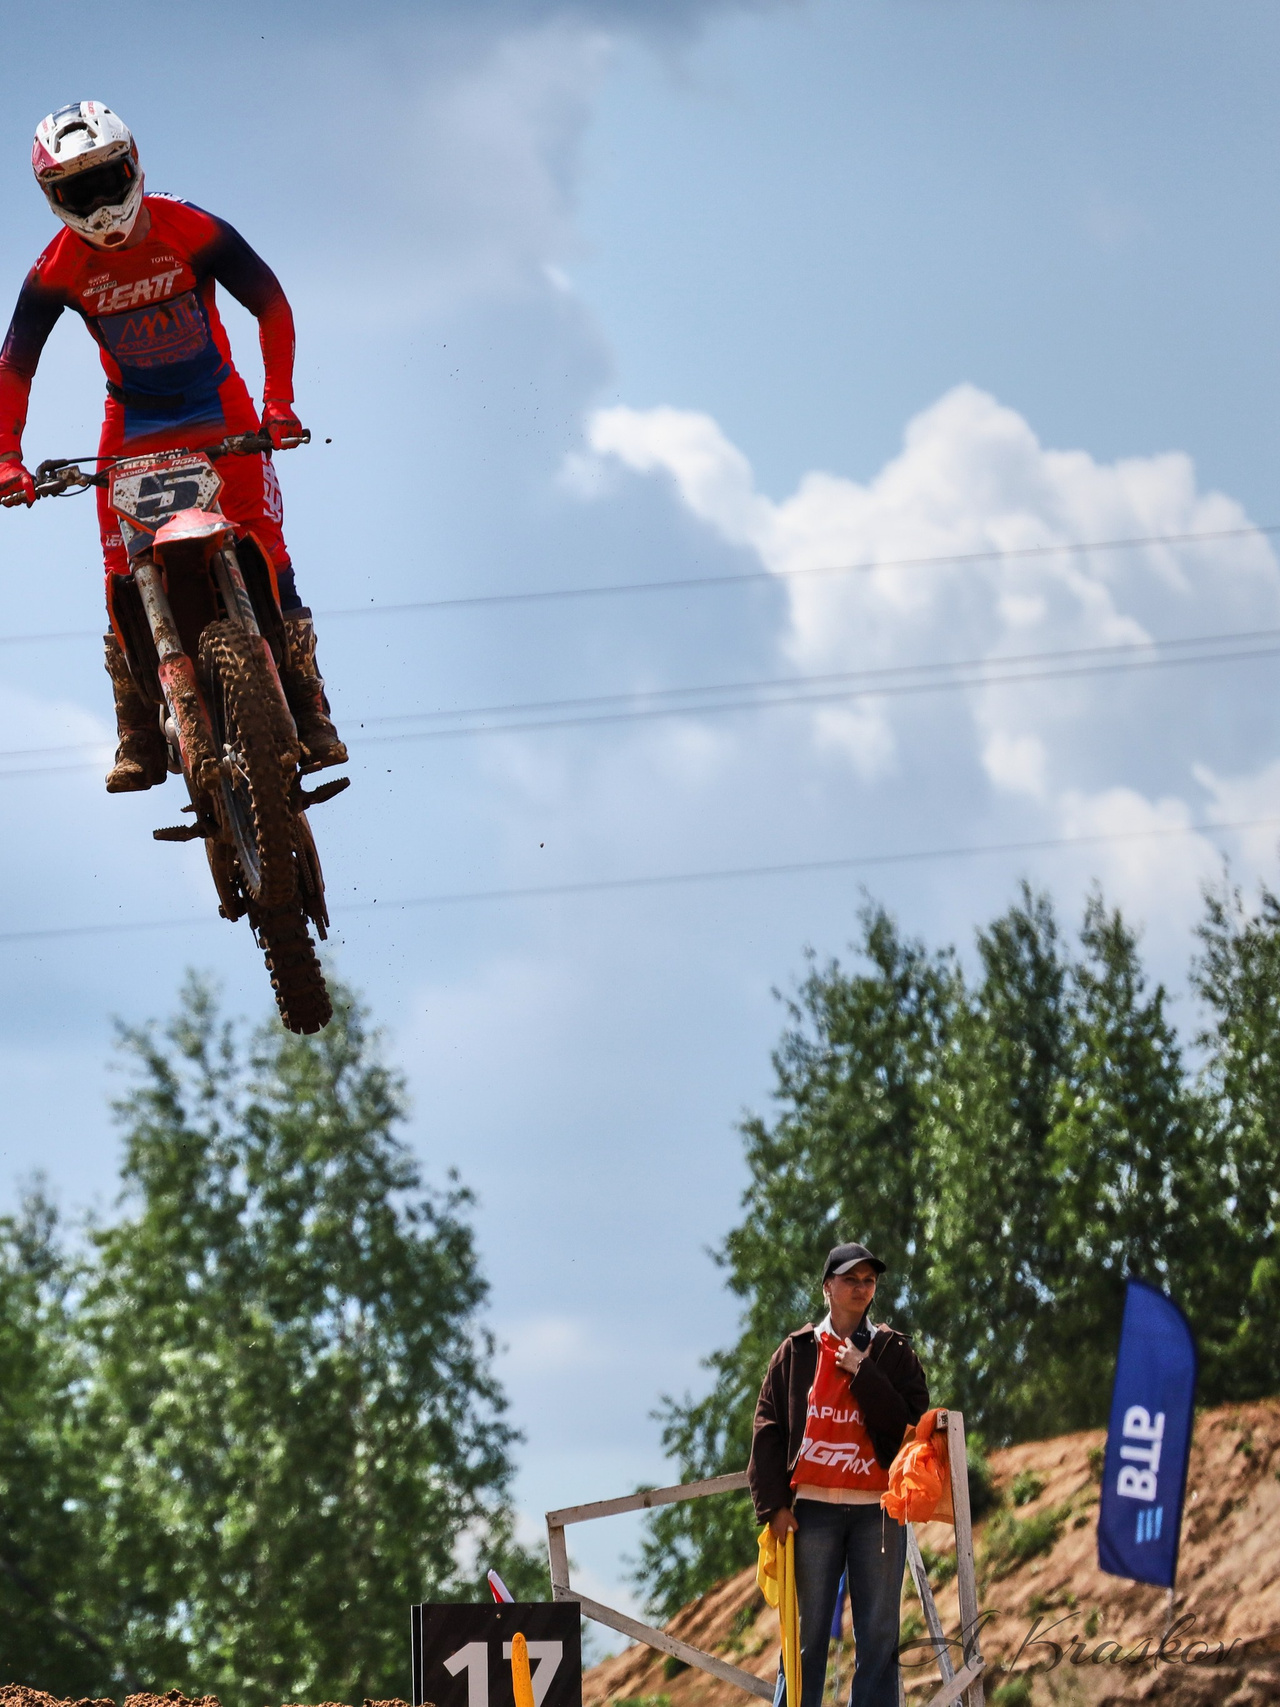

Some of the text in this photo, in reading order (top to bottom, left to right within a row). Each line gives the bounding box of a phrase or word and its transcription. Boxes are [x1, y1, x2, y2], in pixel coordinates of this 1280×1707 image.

[97, 268, 183, 312] LEATT
[135, 465, 205, 518] 5
[442, 1640, 563, 1707] 17
